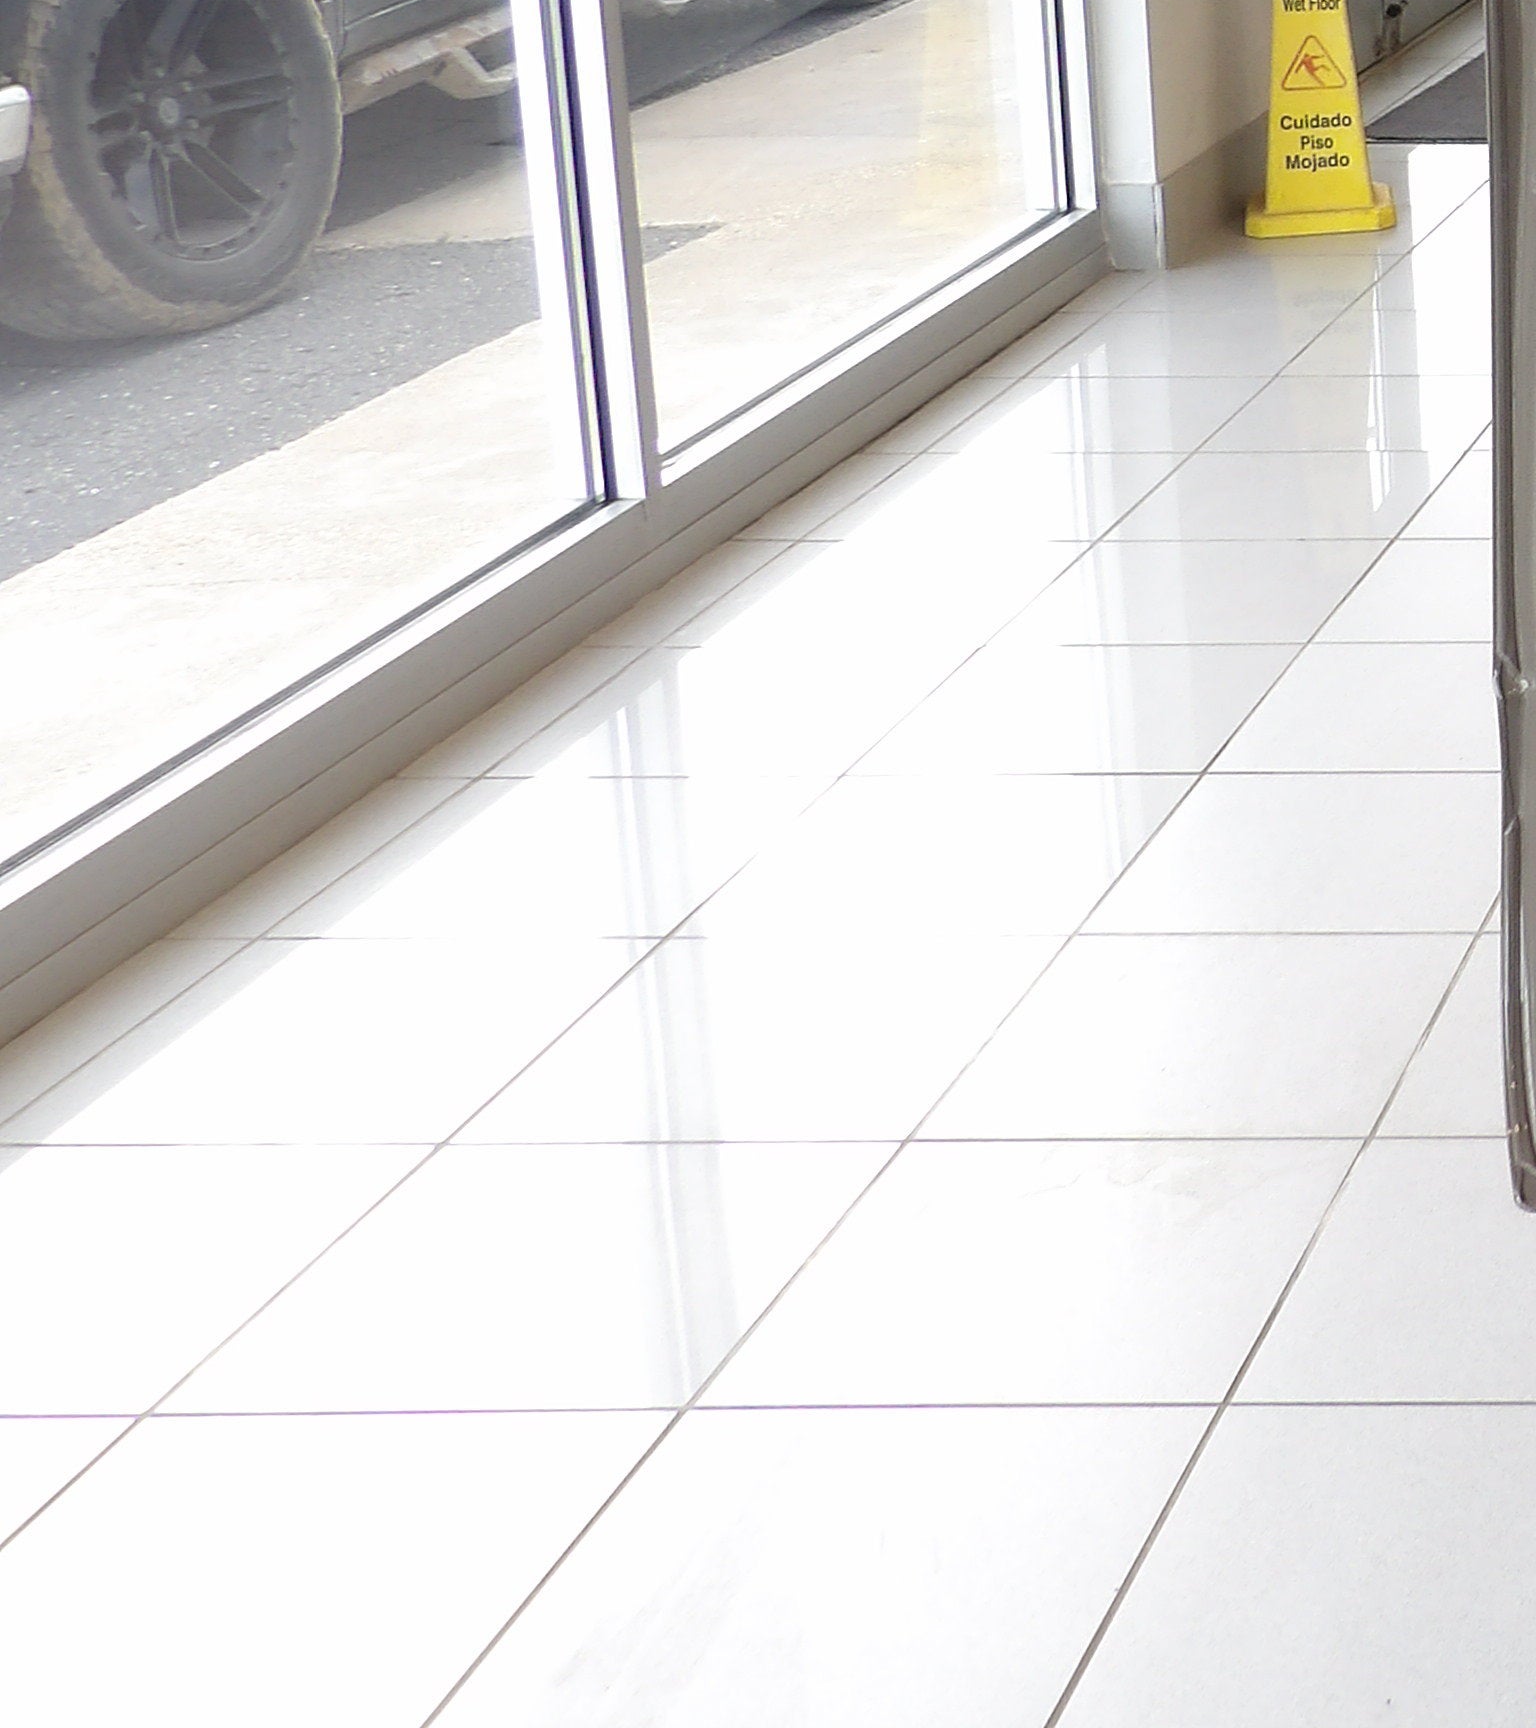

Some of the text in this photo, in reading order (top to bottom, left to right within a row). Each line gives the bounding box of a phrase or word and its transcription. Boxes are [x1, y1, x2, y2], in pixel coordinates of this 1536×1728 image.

[1280, 113, 1352, 130] Cuidado
[1301, 135, 1334, 150] Piso
[1286, 153, 1350, 172] Mojado
